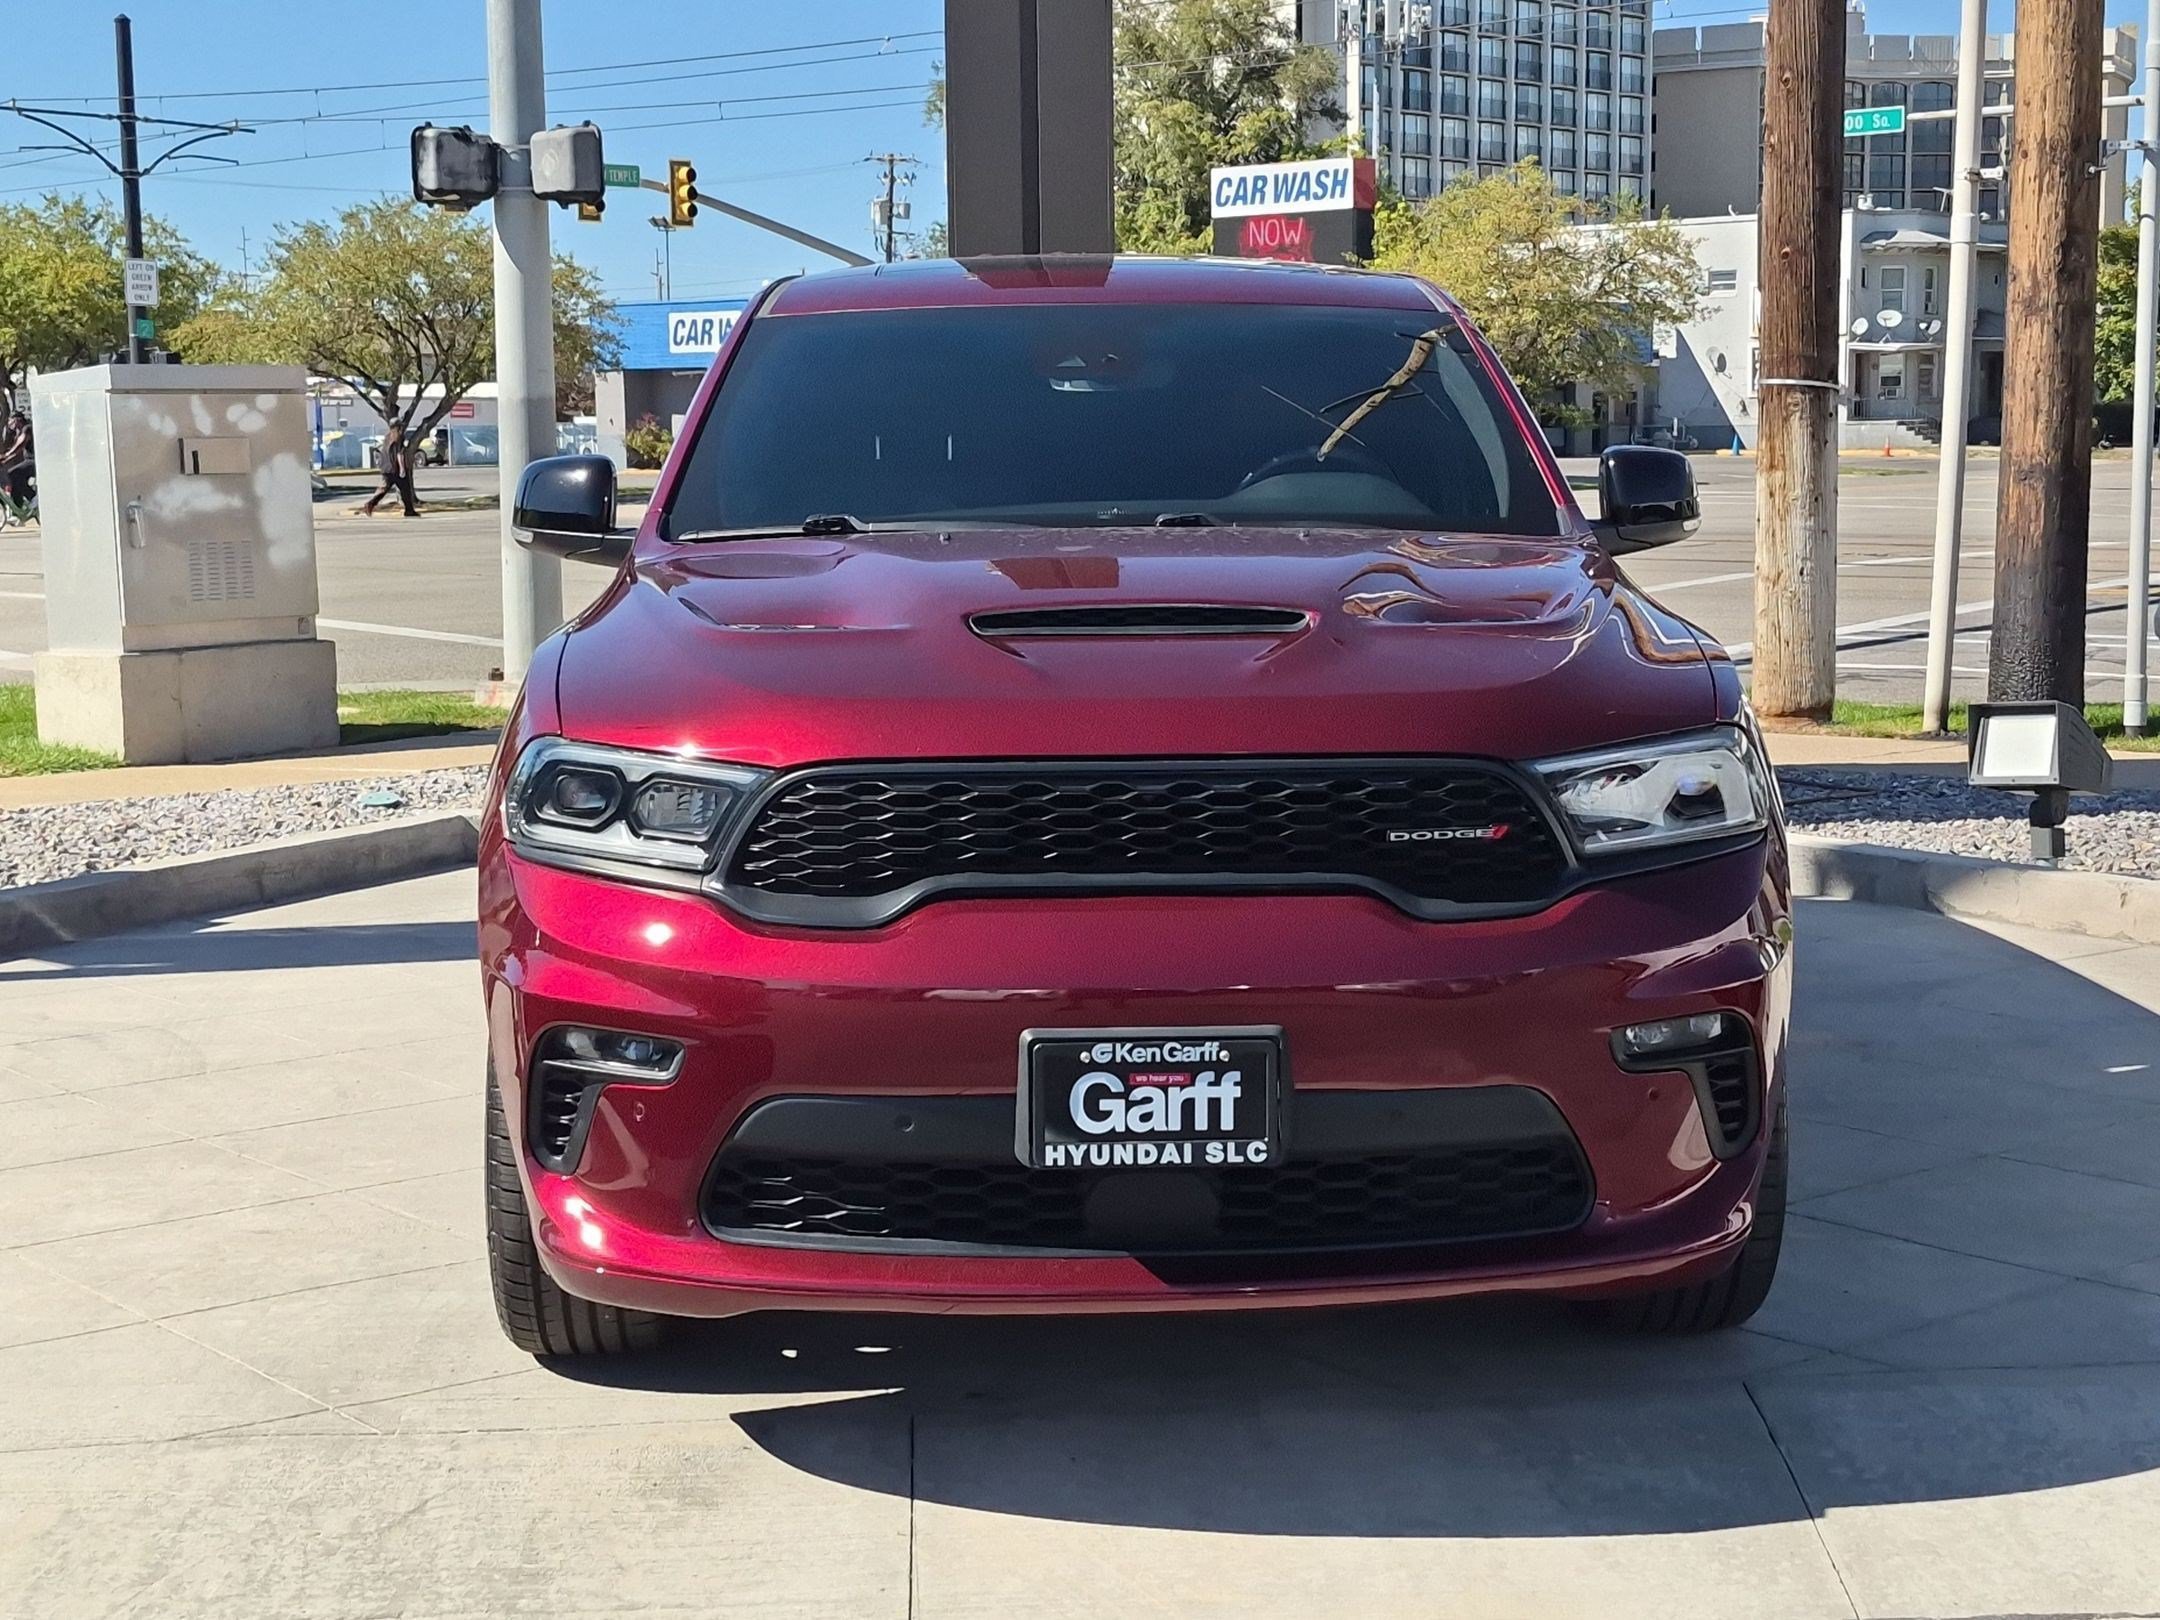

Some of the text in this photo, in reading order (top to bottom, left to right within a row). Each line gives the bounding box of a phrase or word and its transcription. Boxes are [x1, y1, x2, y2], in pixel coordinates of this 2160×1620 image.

[1845, 115, 1863, 131] 00
[608, 169, 638, 183] TEMPLE
[1215, 168, 1349, 207] CAR WASH
[1249, 217, 1304, 247] NOW
[128, 263, 155, 272] LEFT ON
[131, 273, 153, 282] GREEN
[131, 284, 153, 292] ARROW
[134, 294, 150, 302] ONLY
[673, 318, 714, 347] CAR
[1390, 828, 1495, 842] DODGE
[1116, 1041, 1221, 1063] Ken Garff
[1149, 1074, 1168, 1083] hear
[1168, 1075, 1184, 1084] you
[1069, 1070, 1242, 1135] Garff
[1045, 1141, 1268, 1167] HYUNDAI SLC
